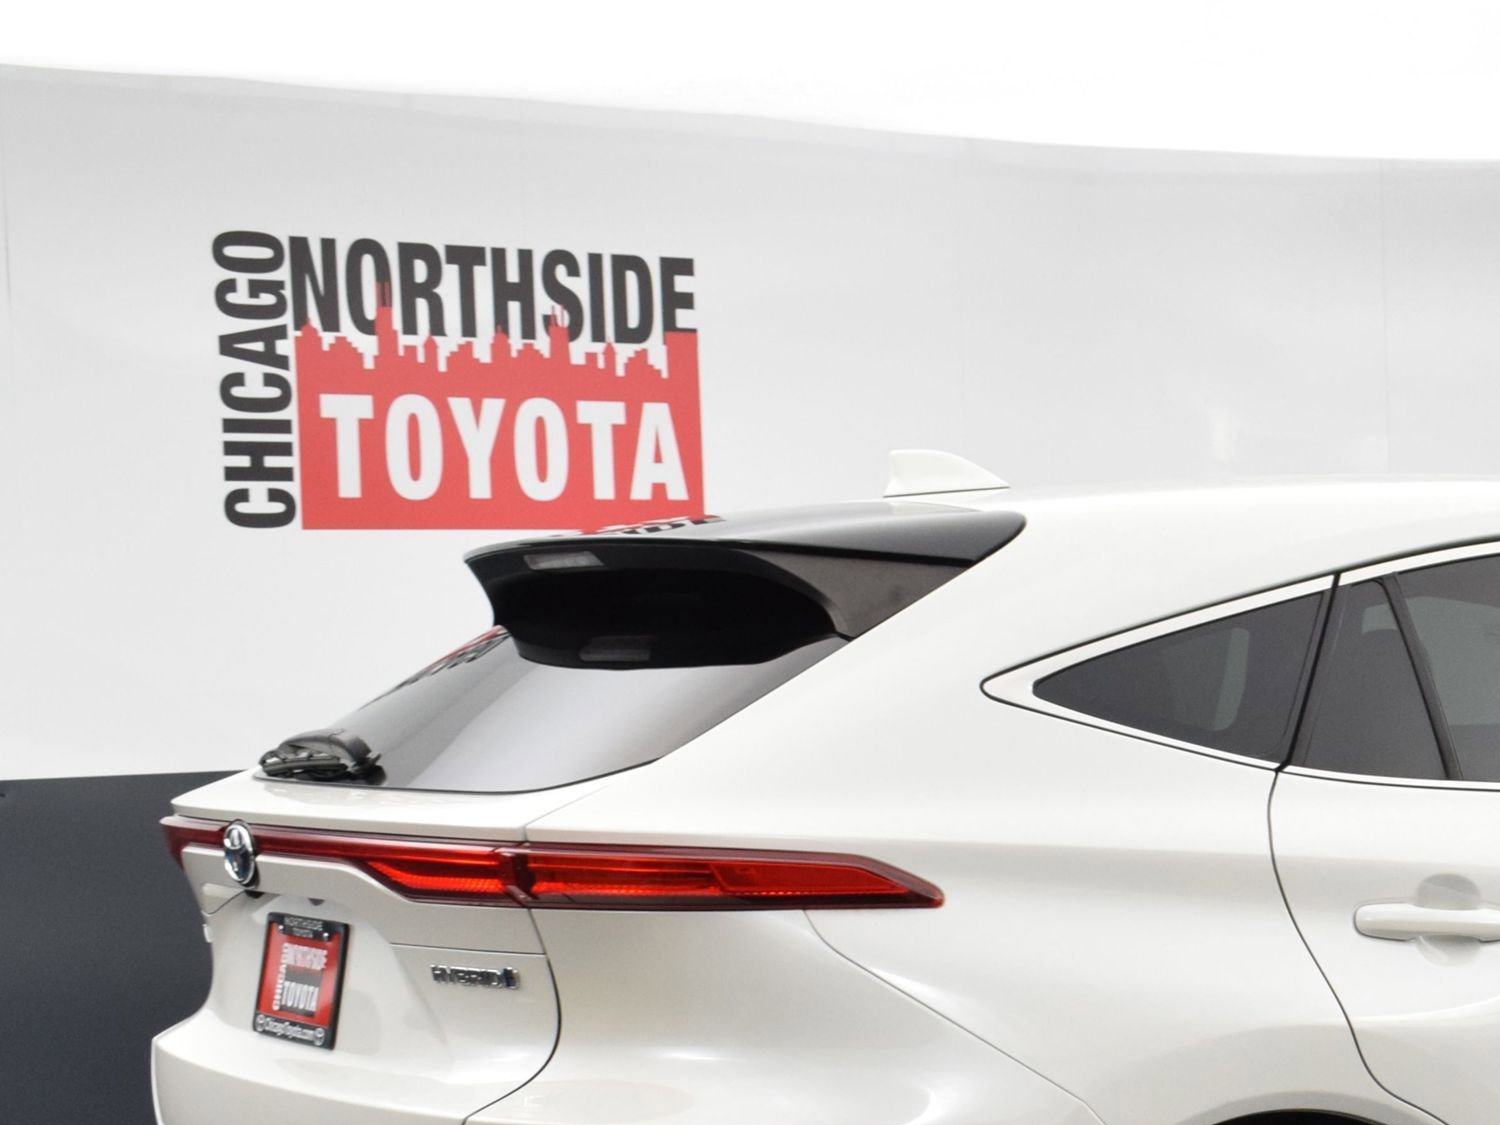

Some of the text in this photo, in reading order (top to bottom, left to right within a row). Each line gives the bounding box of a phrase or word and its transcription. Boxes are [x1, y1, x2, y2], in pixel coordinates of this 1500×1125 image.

[288, 235, 698, 345] NORTHSIDE
[212, 230, 296, 529] CHICAGO
[319, 393, 689, 502] TOYOTA
[281, 981, 320, 1012] TOYOTA
[429, 964, 503, 989] HYBRID
